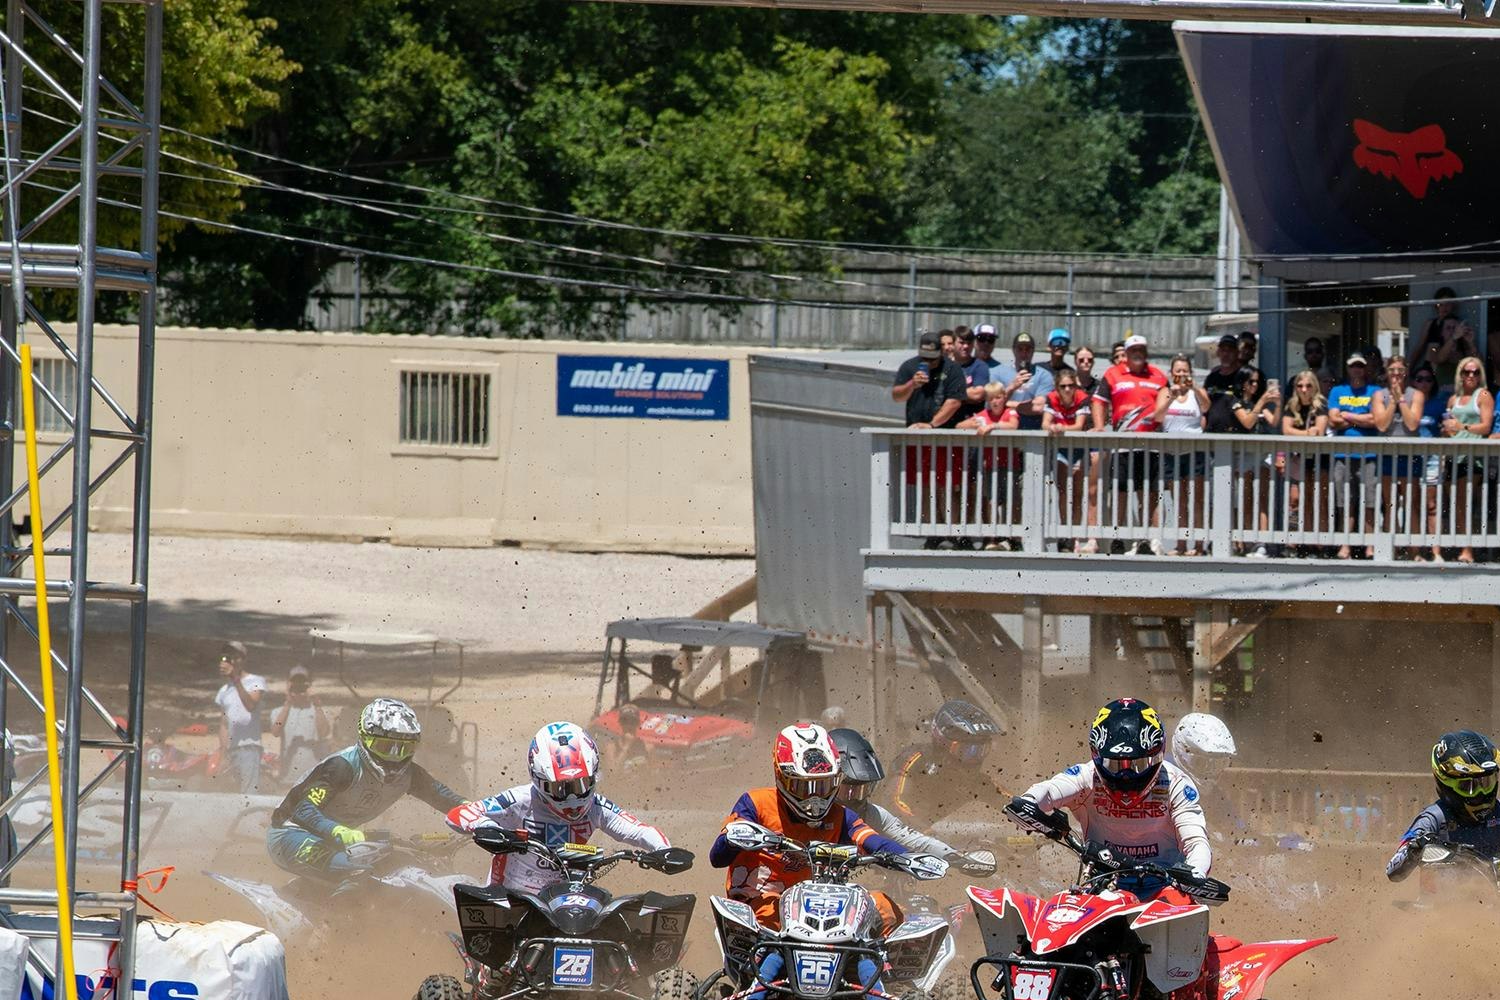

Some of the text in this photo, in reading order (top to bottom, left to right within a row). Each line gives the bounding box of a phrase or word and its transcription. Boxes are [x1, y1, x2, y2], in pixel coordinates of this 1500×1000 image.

[570, 362, 716, 392] mobile mini
[556, 954, 591, 975] 28
[802, 960, 831, 985] 26
[1014, 973, 1051, 1000] 88
